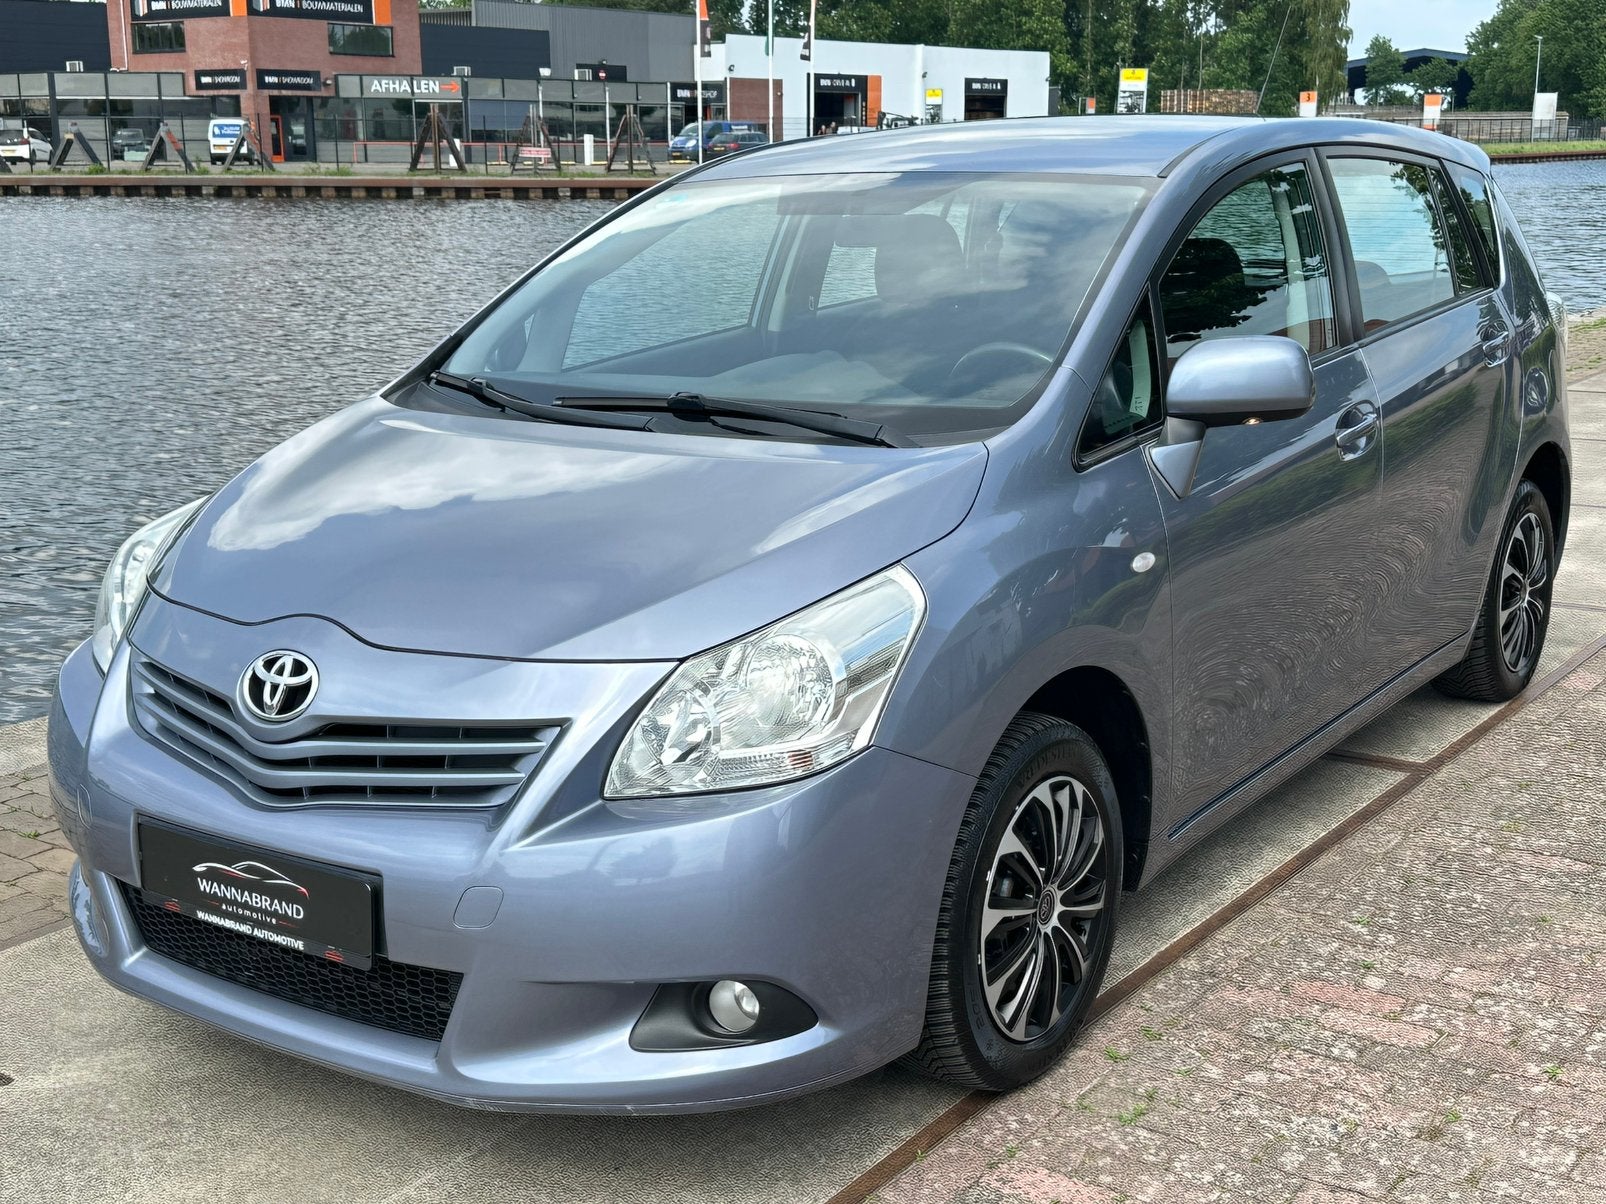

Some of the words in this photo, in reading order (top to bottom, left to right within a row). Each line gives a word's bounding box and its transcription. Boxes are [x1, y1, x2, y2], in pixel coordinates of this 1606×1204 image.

[371, 79, 439, 93] AFHALEN
[197, 877, 304, 919] WANNABRAND
[221, 903, 277, 924] automotive
[196, 910, 252, 934] WANNABRAND
[253, 927, 304, 950] AUTOMOTIVE
